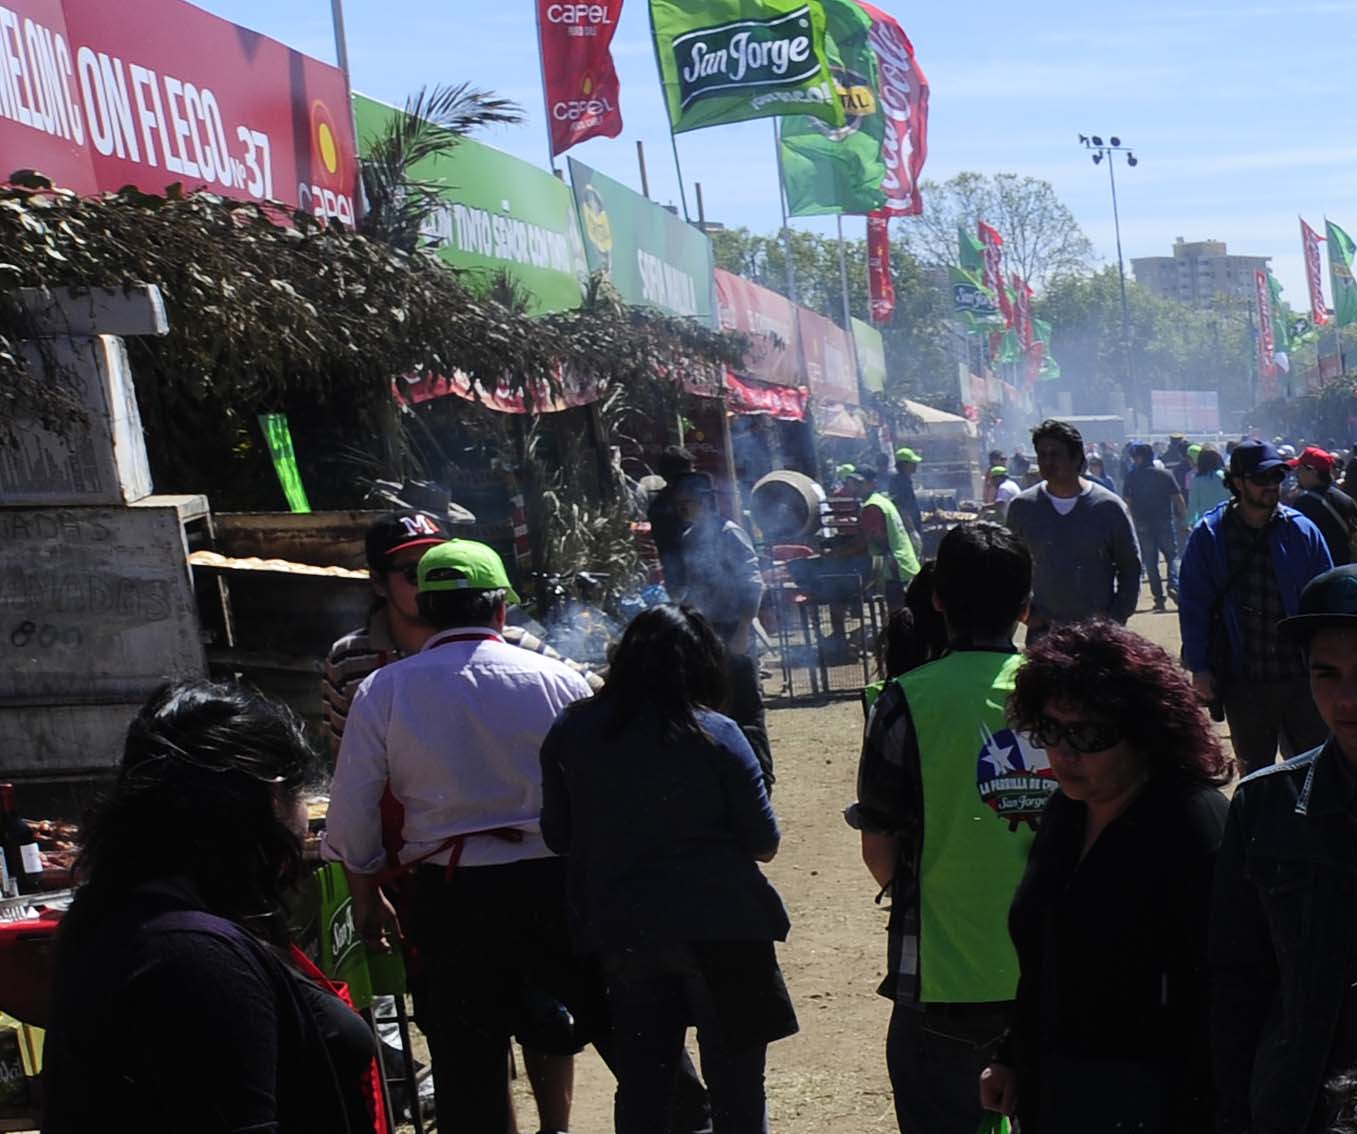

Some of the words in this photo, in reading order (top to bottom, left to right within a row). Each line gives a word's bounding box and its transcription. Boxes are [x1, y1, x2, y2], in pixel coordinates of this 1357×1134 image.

[683, 42, 727, 82] San
[729, 32, 811, 80] Jorge
[129, 63, 234, 187] FLECO
